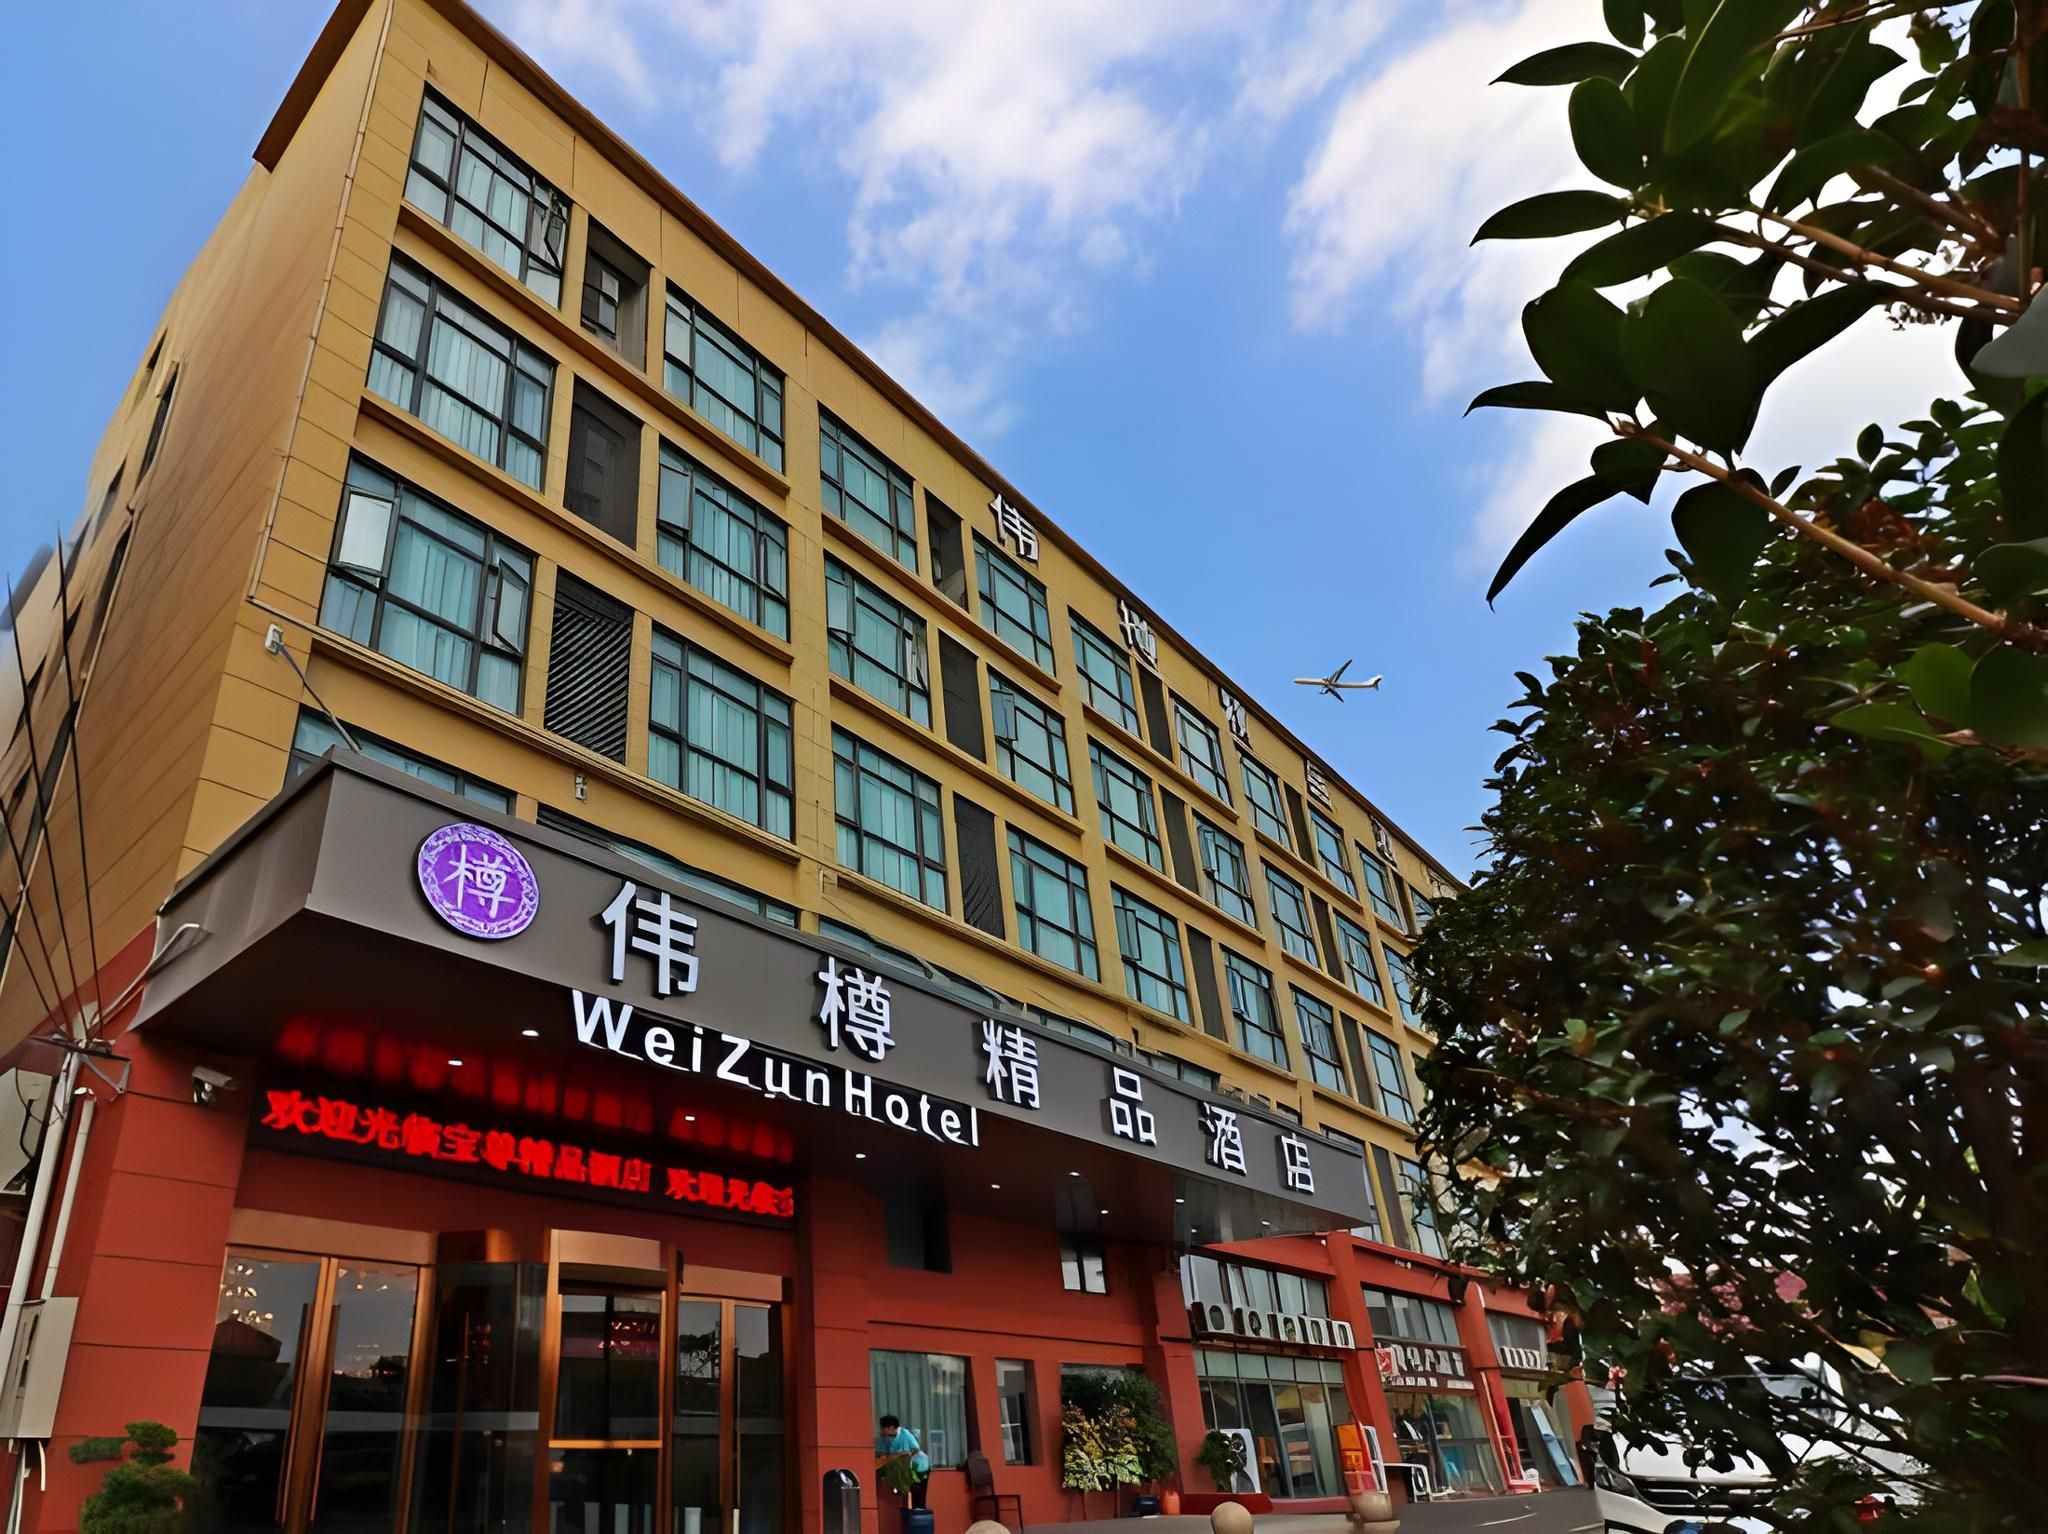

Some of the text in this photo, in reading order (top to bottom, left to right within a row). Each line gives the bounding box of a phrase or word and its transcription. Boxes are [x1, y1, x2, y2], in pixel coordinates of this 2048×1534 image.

[601, 881, 1315, 1195] 伟樽精品酒店
